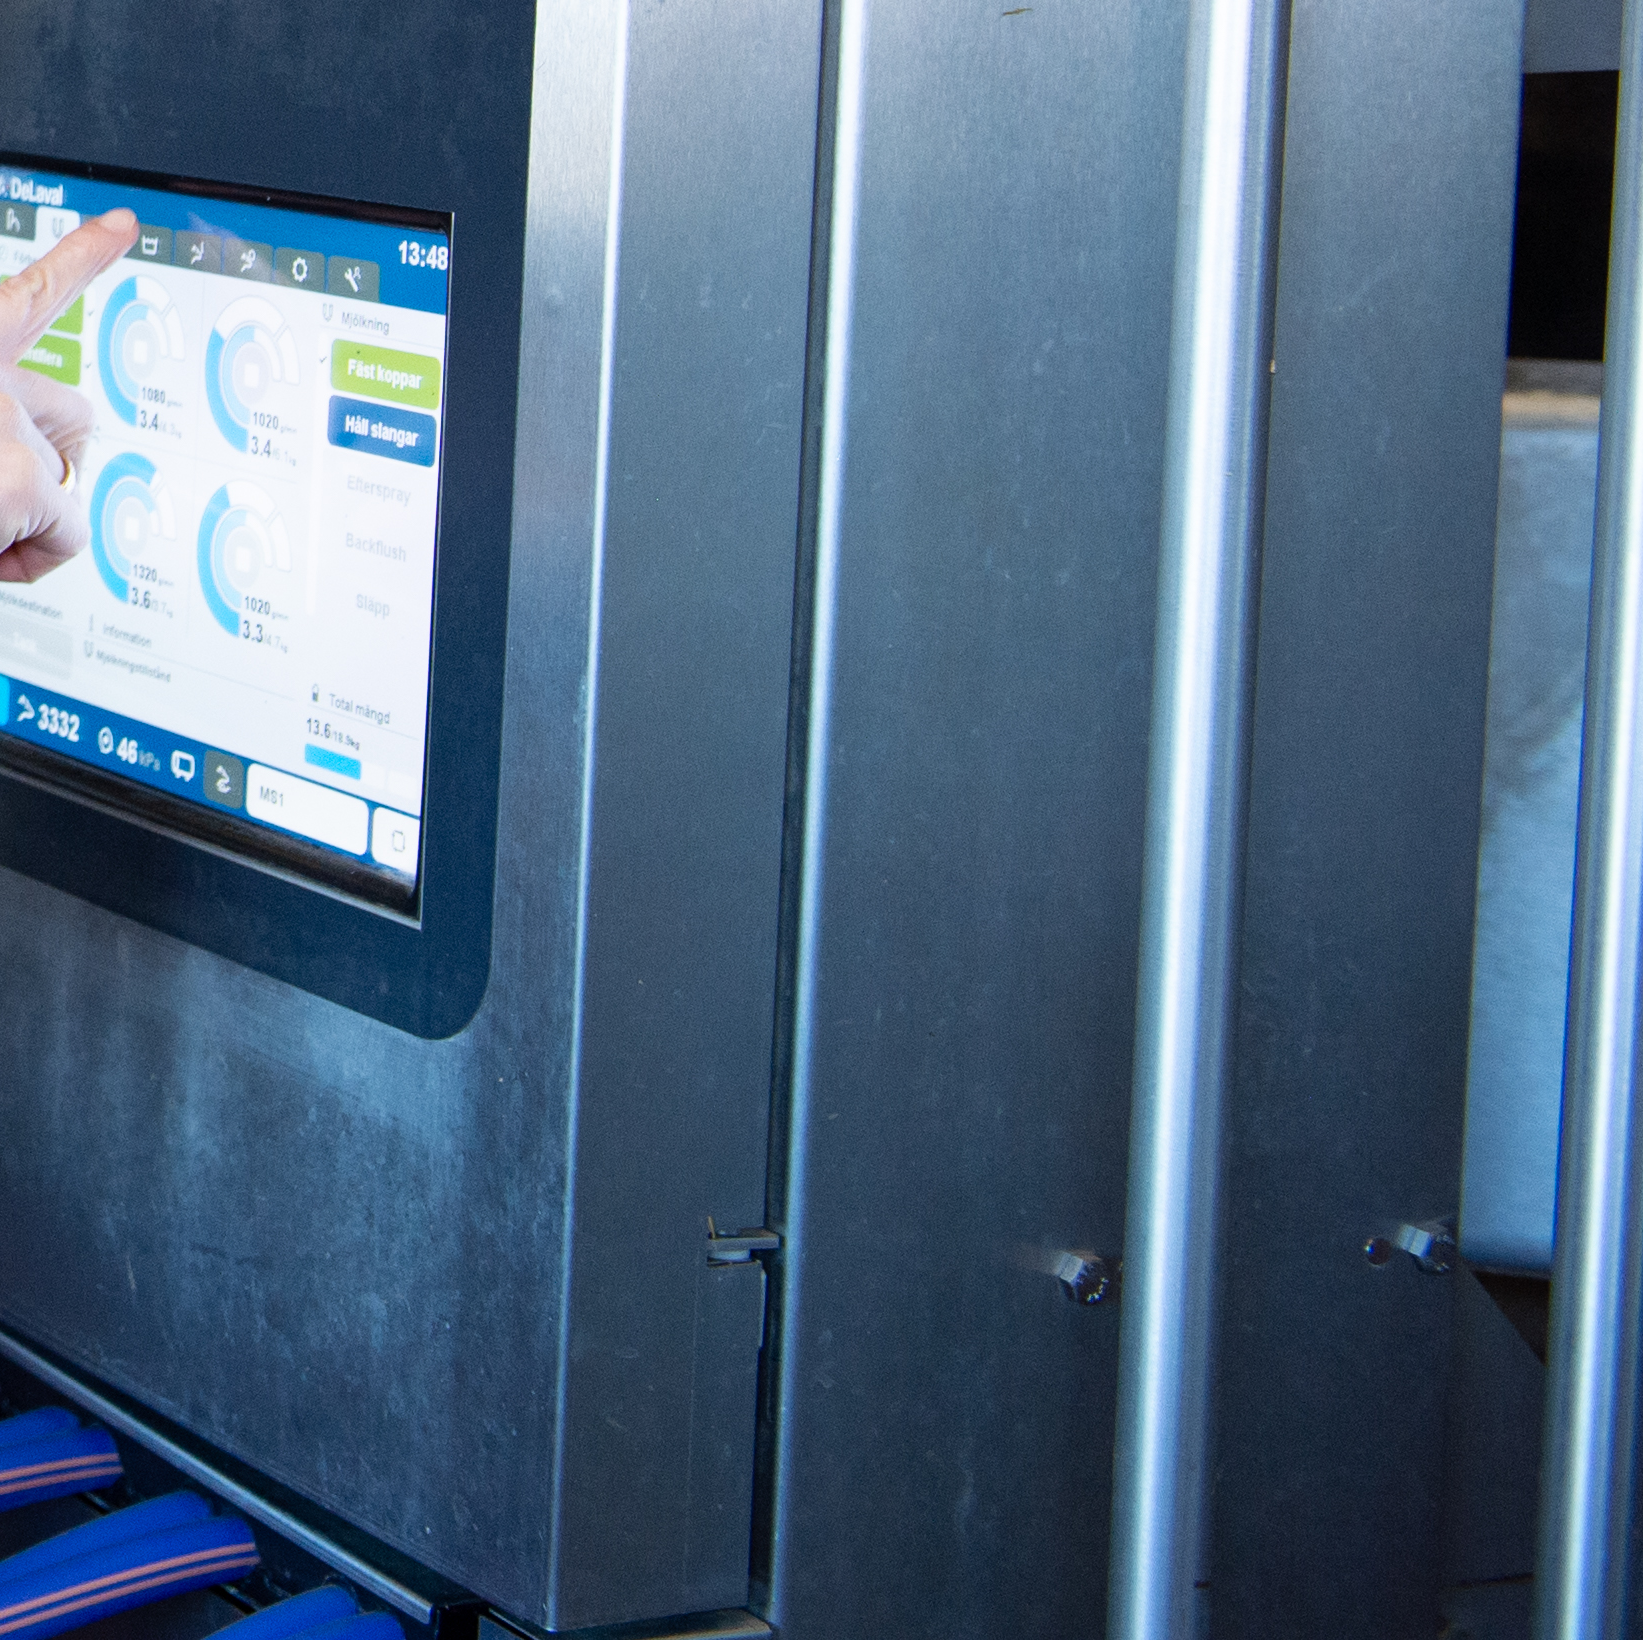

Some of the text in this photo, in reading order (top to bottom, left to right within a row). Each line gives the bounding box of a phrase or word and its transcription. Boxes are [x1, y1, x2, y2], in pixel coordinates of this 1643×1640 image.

[9, 175, 64, 207] DeLaval
[398, 239, 449, 271] 13:48
[341, 311, 390, 336] Mjölkning
[347, 358, 423, 391] Fäst koppar
[142, 386, 166, 404] 1080
[253, 411, 279, 430] 1020
[344, 414, 419, 448] Håll slangar
[346, 474, 411, 508] Efterspray
[345, 531, 407, 562] Backflush
[133, 563, 158, 583] 1320
[244, 595, 271, 616] 1020
[356, 593, 391, 620] Släpp
[329, 693, 391, 725] Total mängd
[37, 702, 81, 743] 3332
[116, 737, 139, 765] 46
[259, 784, 284, 807] MS1
